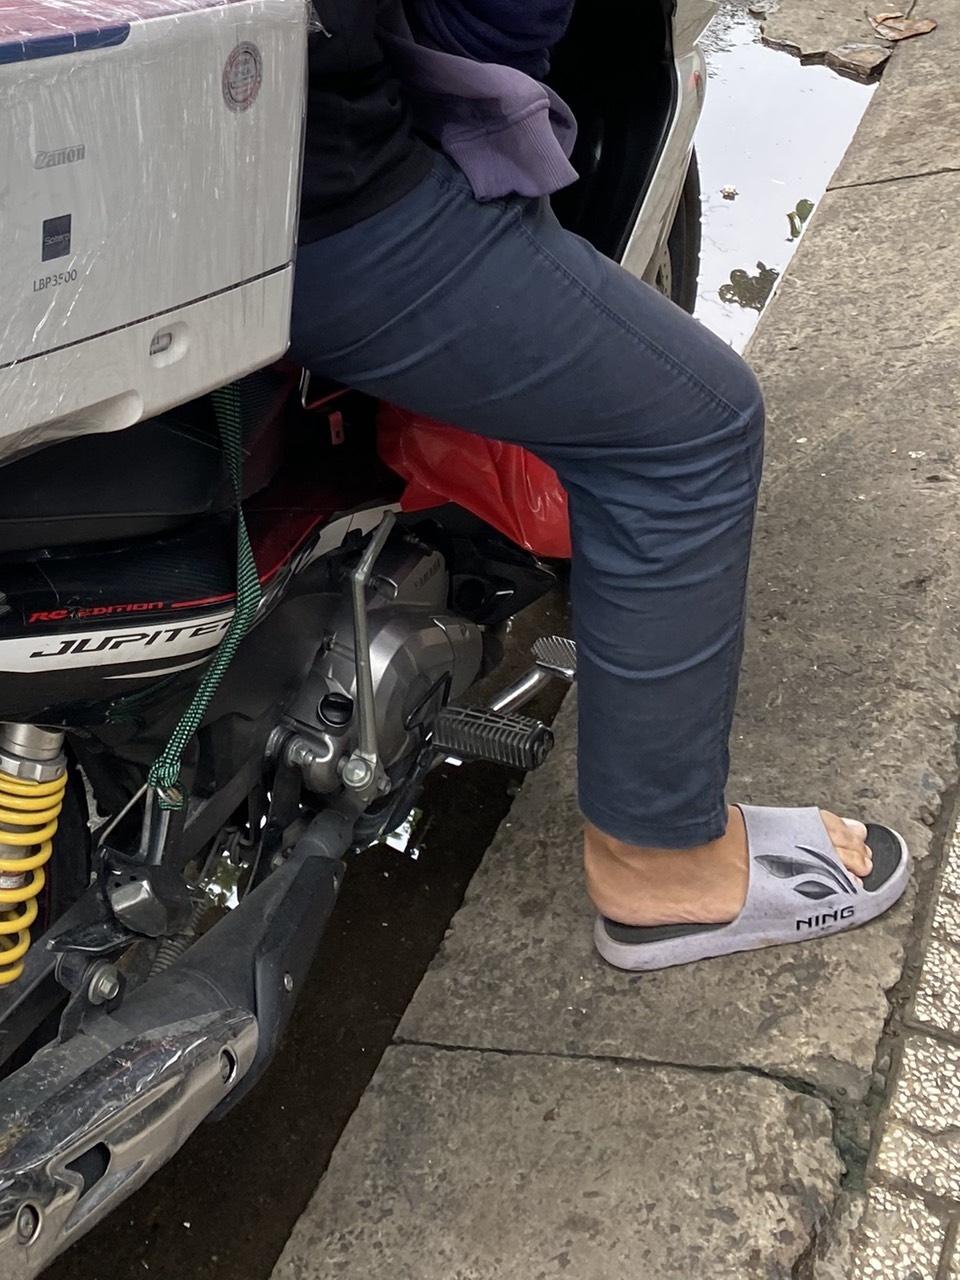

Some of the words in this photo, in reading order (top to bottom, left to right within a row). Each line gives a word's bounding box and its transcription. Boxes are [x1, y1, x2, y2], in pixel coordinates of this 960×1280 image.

[33, 144, 86, 170] Canon
[28, 609, 68, 623] RC
[796, 906, 854, 931] NING
